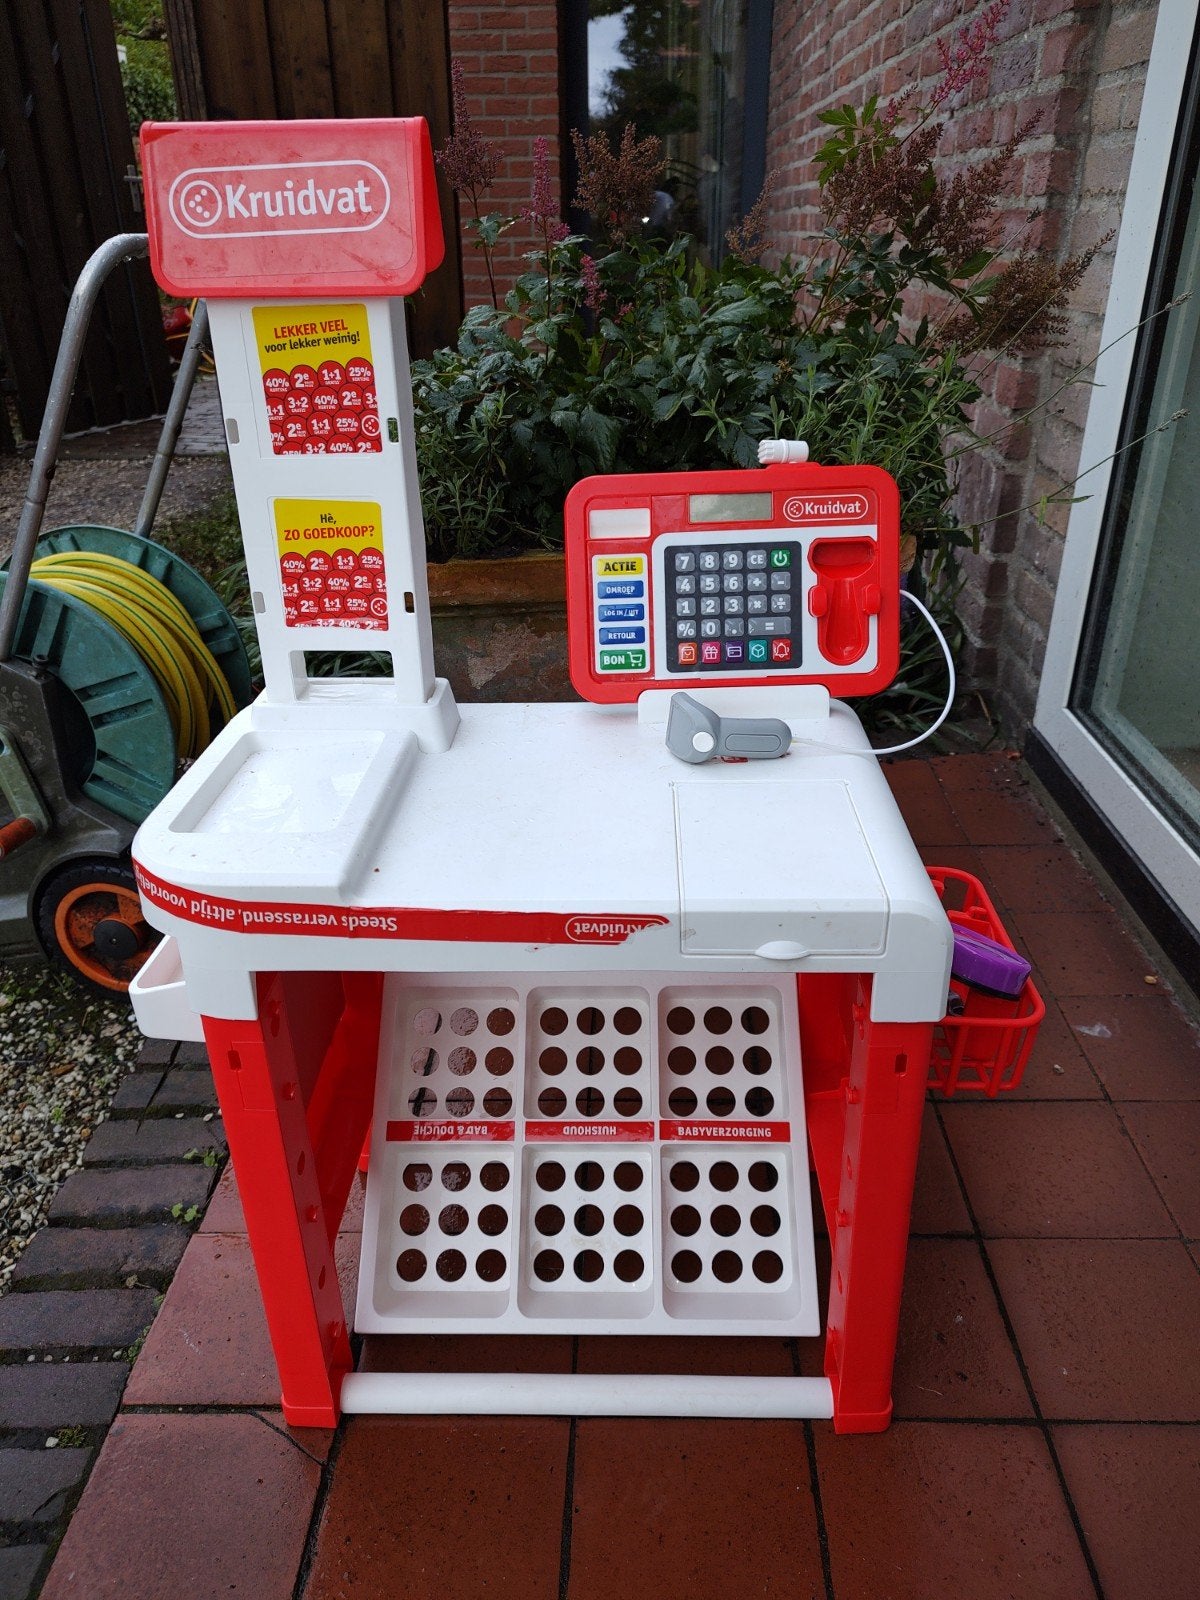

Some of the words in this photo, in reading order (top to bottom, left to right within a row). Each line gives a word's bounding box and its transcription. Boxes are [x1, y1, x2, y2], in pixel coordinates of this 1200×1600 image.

[225, 179, 372, 218] Kruidvat
[274, 322, 318, 338] LEKKER
[320, 319, 348, 331] VEEL
[265, 342, 286, 353] voor
[290, 338, 321, 350] lekker
[323, 331, 360, 345] weinig!
[322, 369, 342, 380] 1+1
[349, 367, 371, 376] 25%
[266, 378, 290, 388] 40%
[288, 397, 308, 408] 3+2
[314, 395, 338, 404] 40%
[311, 419, 330, 430] 1+1
[336, 418, 358, 428] 25%
[805, 500, 861, 515] Kruidvat
[320, 513, 336, 524] Hè,
[284, 530, 300, 541] ZO
[304, 526, 374, 539] GOEDKOOP?
[283, 560, 305, 568] 40%
[336, 556, 354, 566] 1+1
[362, 556, 382, 565] 25%
[680, 556, 690, 570] 7
[704, 554, 714, 568] 8
[728, 554, 738, 568] 9
[750, 554, 764, 565] CE
[604, 562, 636, 572] ACTIE
[302, 578, 322, 588] 3+2
[328, 578, 350, 587] 40%
[680, 578, 690, 592] 4
[705, 577, 714, 590] 5
[729, 576, 738, 590] 6
[606, 586, 635, 594] OMROEP
[324, 598, 341, 608] 1+1
[347, 598, 368, 607] 25%
[682, 600, 690, 614] 1
[706, 600, 715, 612] 2
[729, 598, 738, 612] 3
[679, 624, 694, 637] %
[706, 622, 716, 636] 0
[604, 656, 625, 665] BON
[190, 902, 235, 922] altijd
[238, 910, 336, 926] verrassend,
[342, 914, 398, 931] Steeds
[413, 1126, 454, 1134] DOUCHE
[468, 1126, 488, 1134] BAD
[563, 1126, 616, 1136] HUISHOUD
[678, 1126, 772, 1137] BABYVERZORGING
